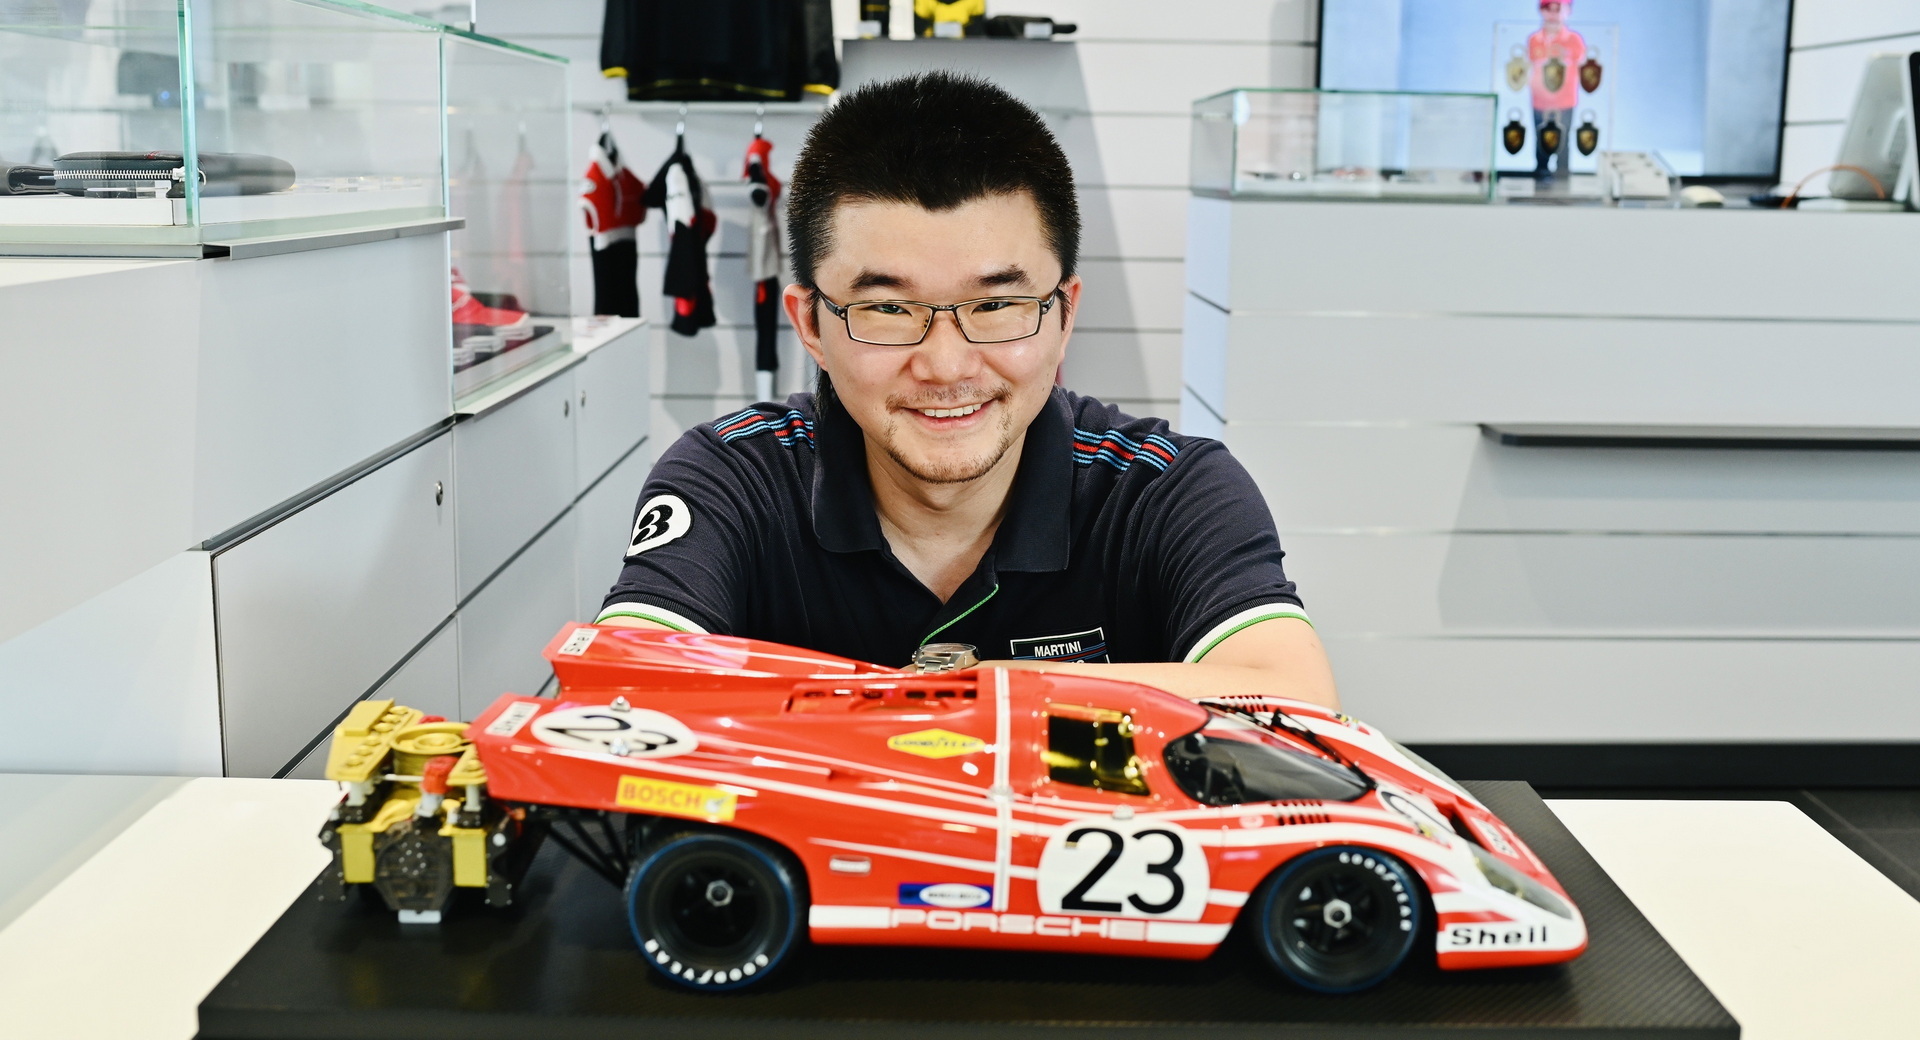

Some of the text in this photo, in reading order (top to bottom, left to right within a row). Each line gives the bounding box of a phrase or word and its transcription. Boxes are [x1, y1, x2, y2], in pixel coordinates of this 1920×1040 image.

[632, 504, 673, 547] 3
[1034, 641, 1082, 657] MARTINI
[545, 714, 678, 752] 23
[622, 782, 701, 809] BOSCH
[1061, 827, 1185, 914] 23
[891, 908, 1147, 941] PORSCHE
[1451, 925, 1547, 946] Shell
